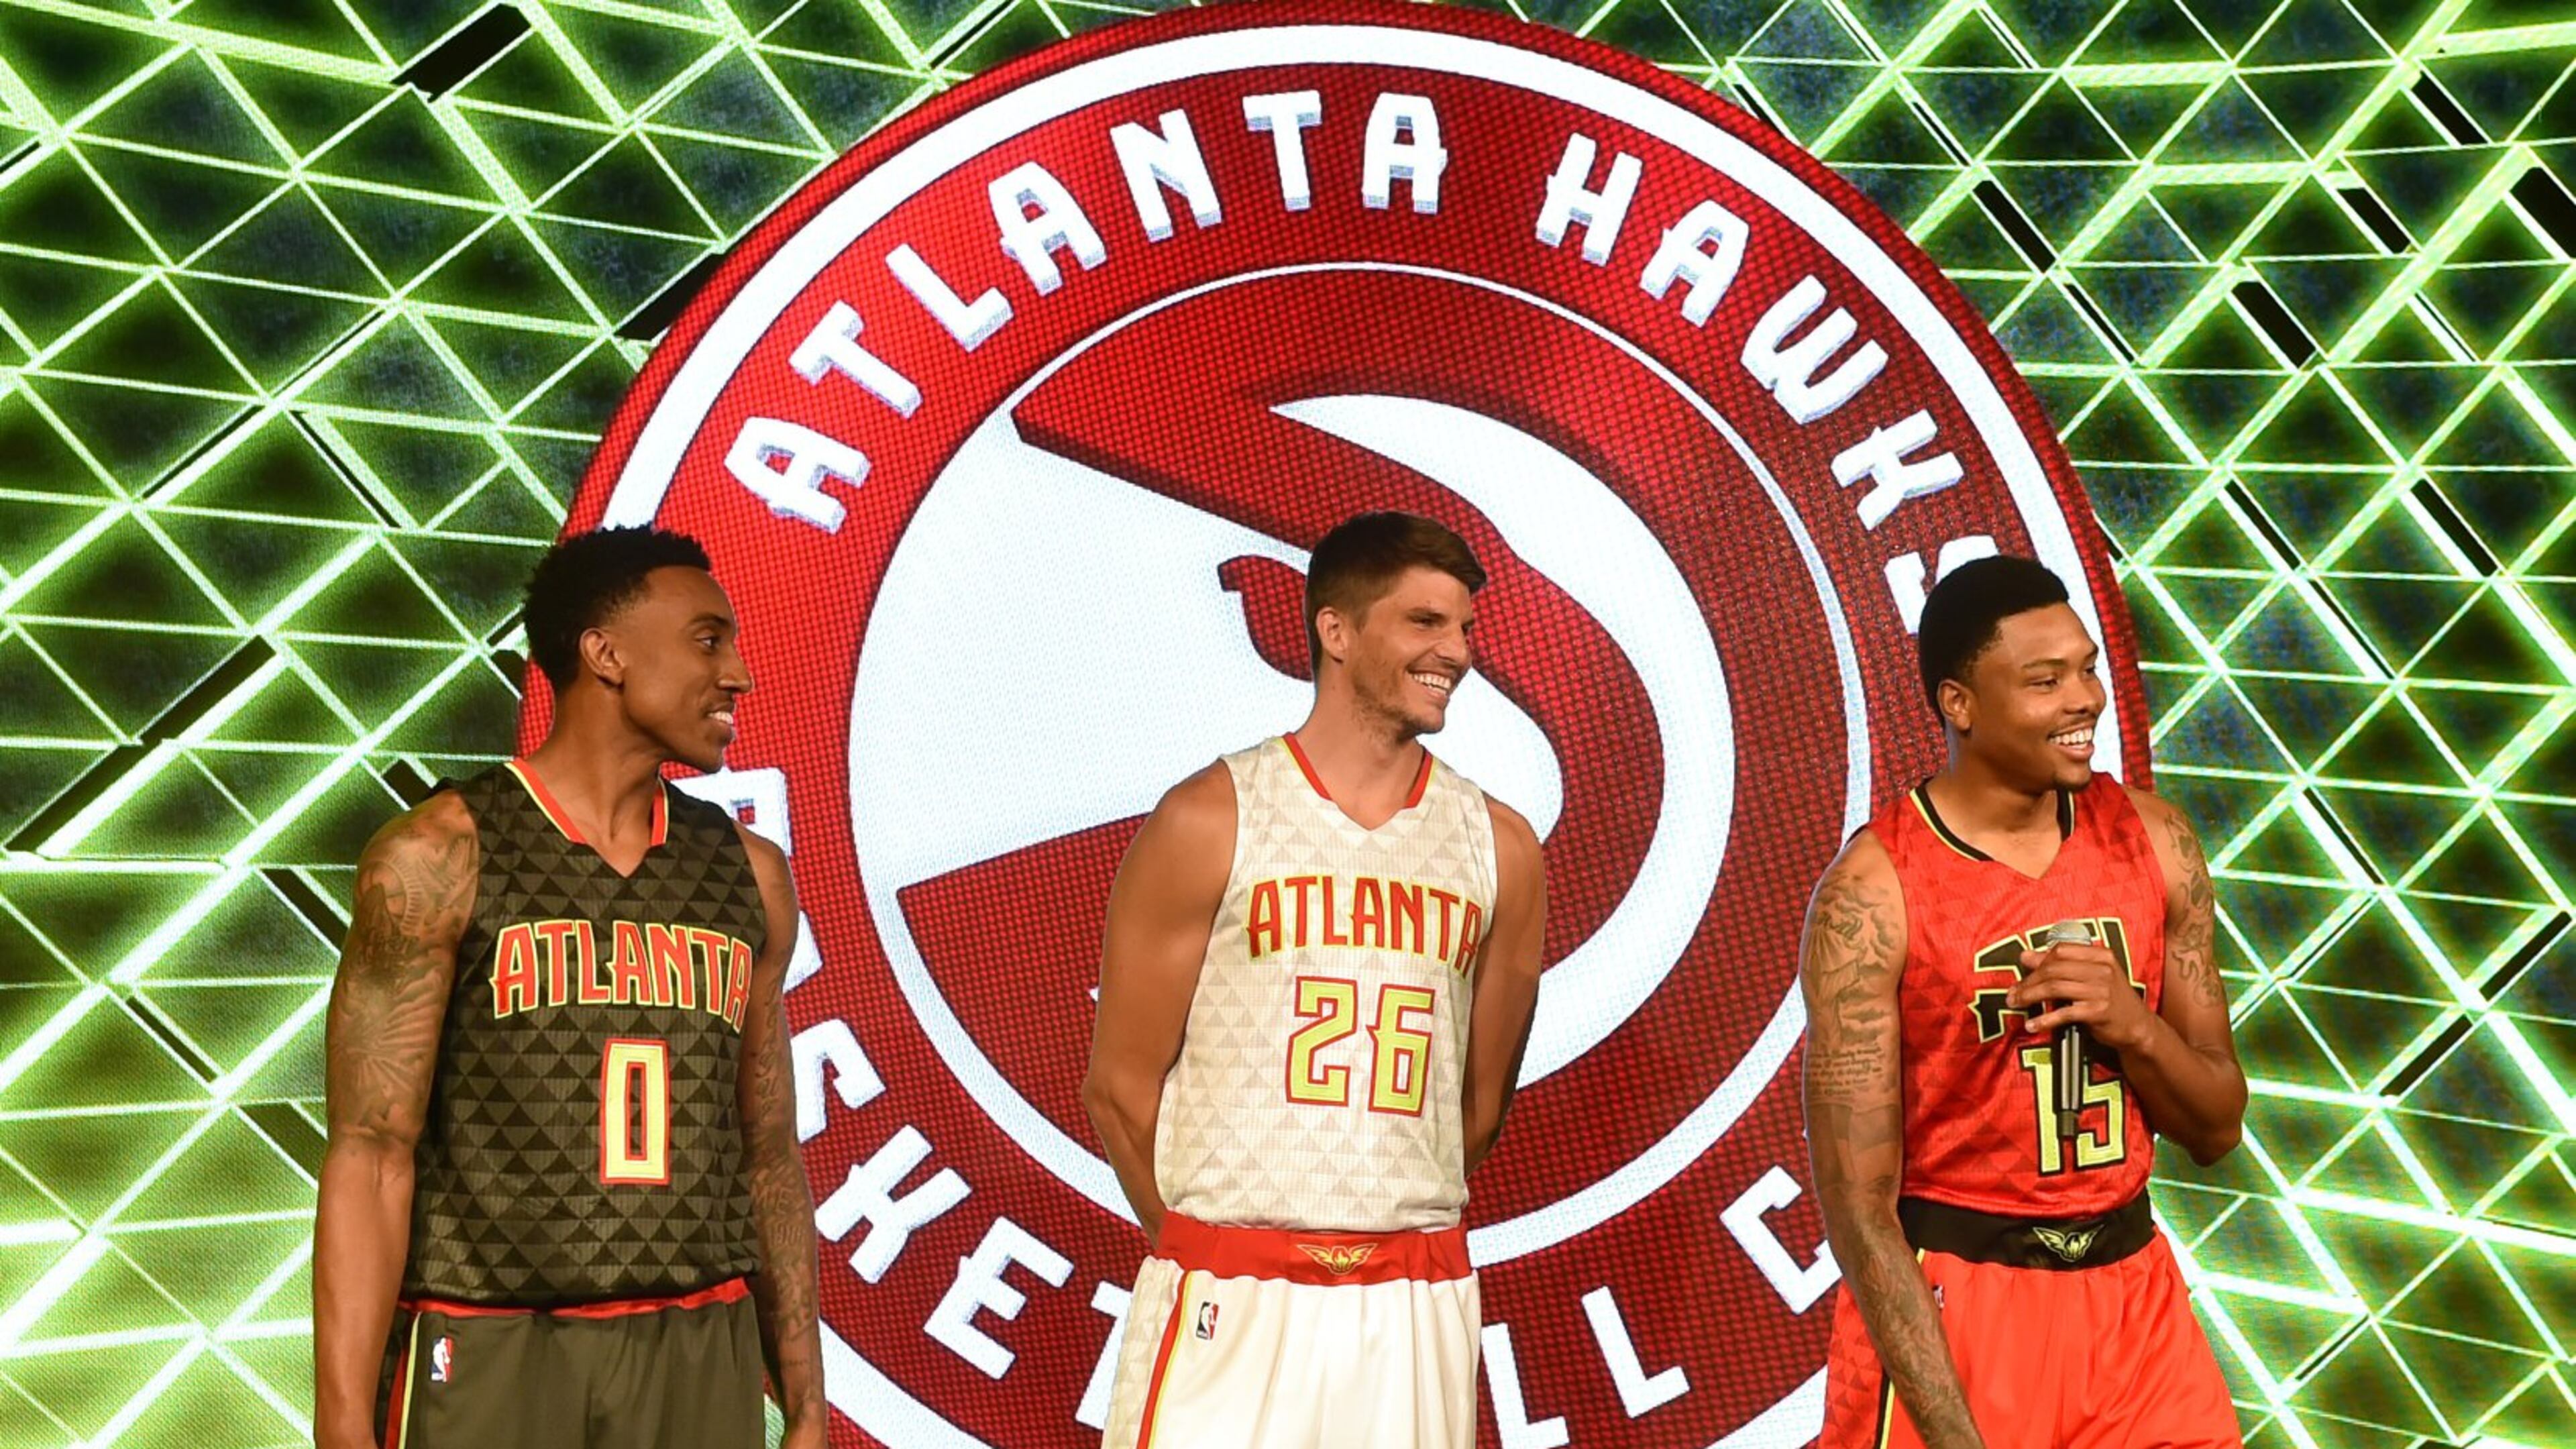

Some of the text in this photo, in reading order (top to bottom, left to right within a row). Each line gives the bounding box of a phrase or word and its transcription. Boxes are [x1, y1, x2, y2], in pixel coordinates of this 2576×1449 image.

[723, 90, 1448, 535] ATLANTA
[489, 920, 753, 1034] ATLANTA
[1246, 875, 1484, 980] ATLANTA
[599, 1038, 672, 1186] 0
[1285, 975, 1436, 1118] 26
[2018, 1044, 2127, 1179] 15
